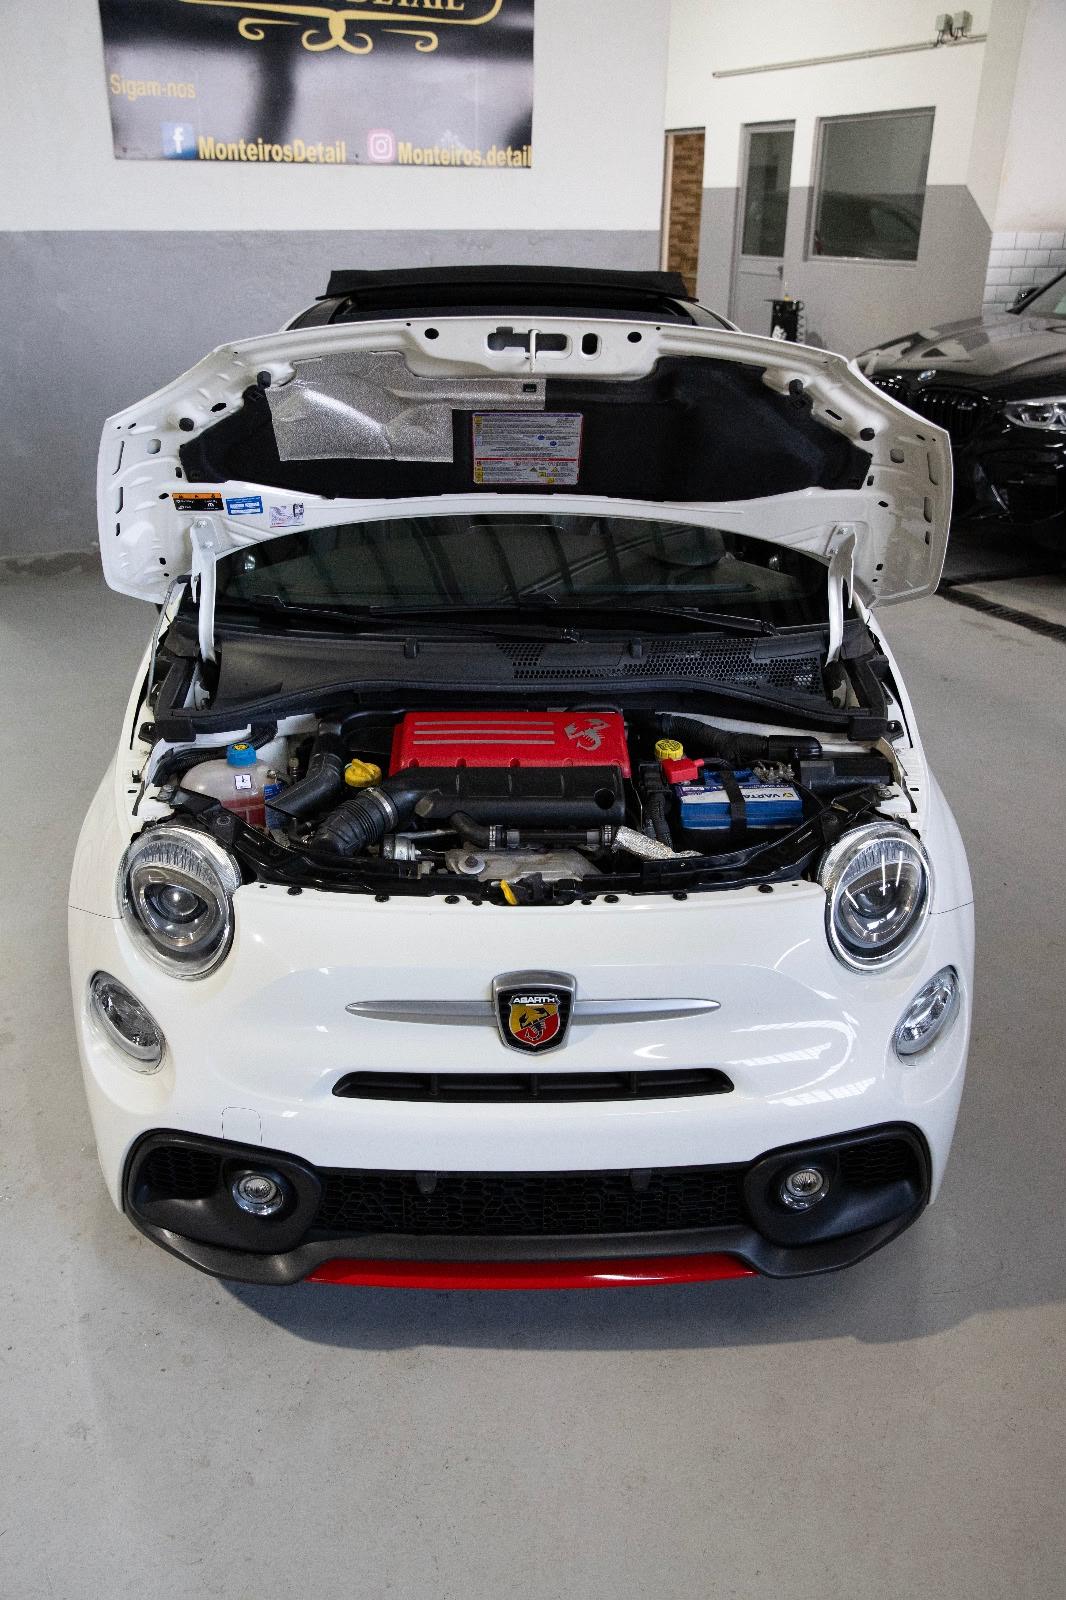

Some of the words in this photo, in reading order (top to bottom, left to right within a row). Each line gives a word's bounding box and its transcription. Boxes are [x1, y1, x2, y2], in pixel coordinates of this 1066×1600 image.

[110, 73, 196, 99] Sigam-nos
[198, 136, 346, 163] MonteirosDetail
[398, 142, 532, 167] Monteiros.detail
